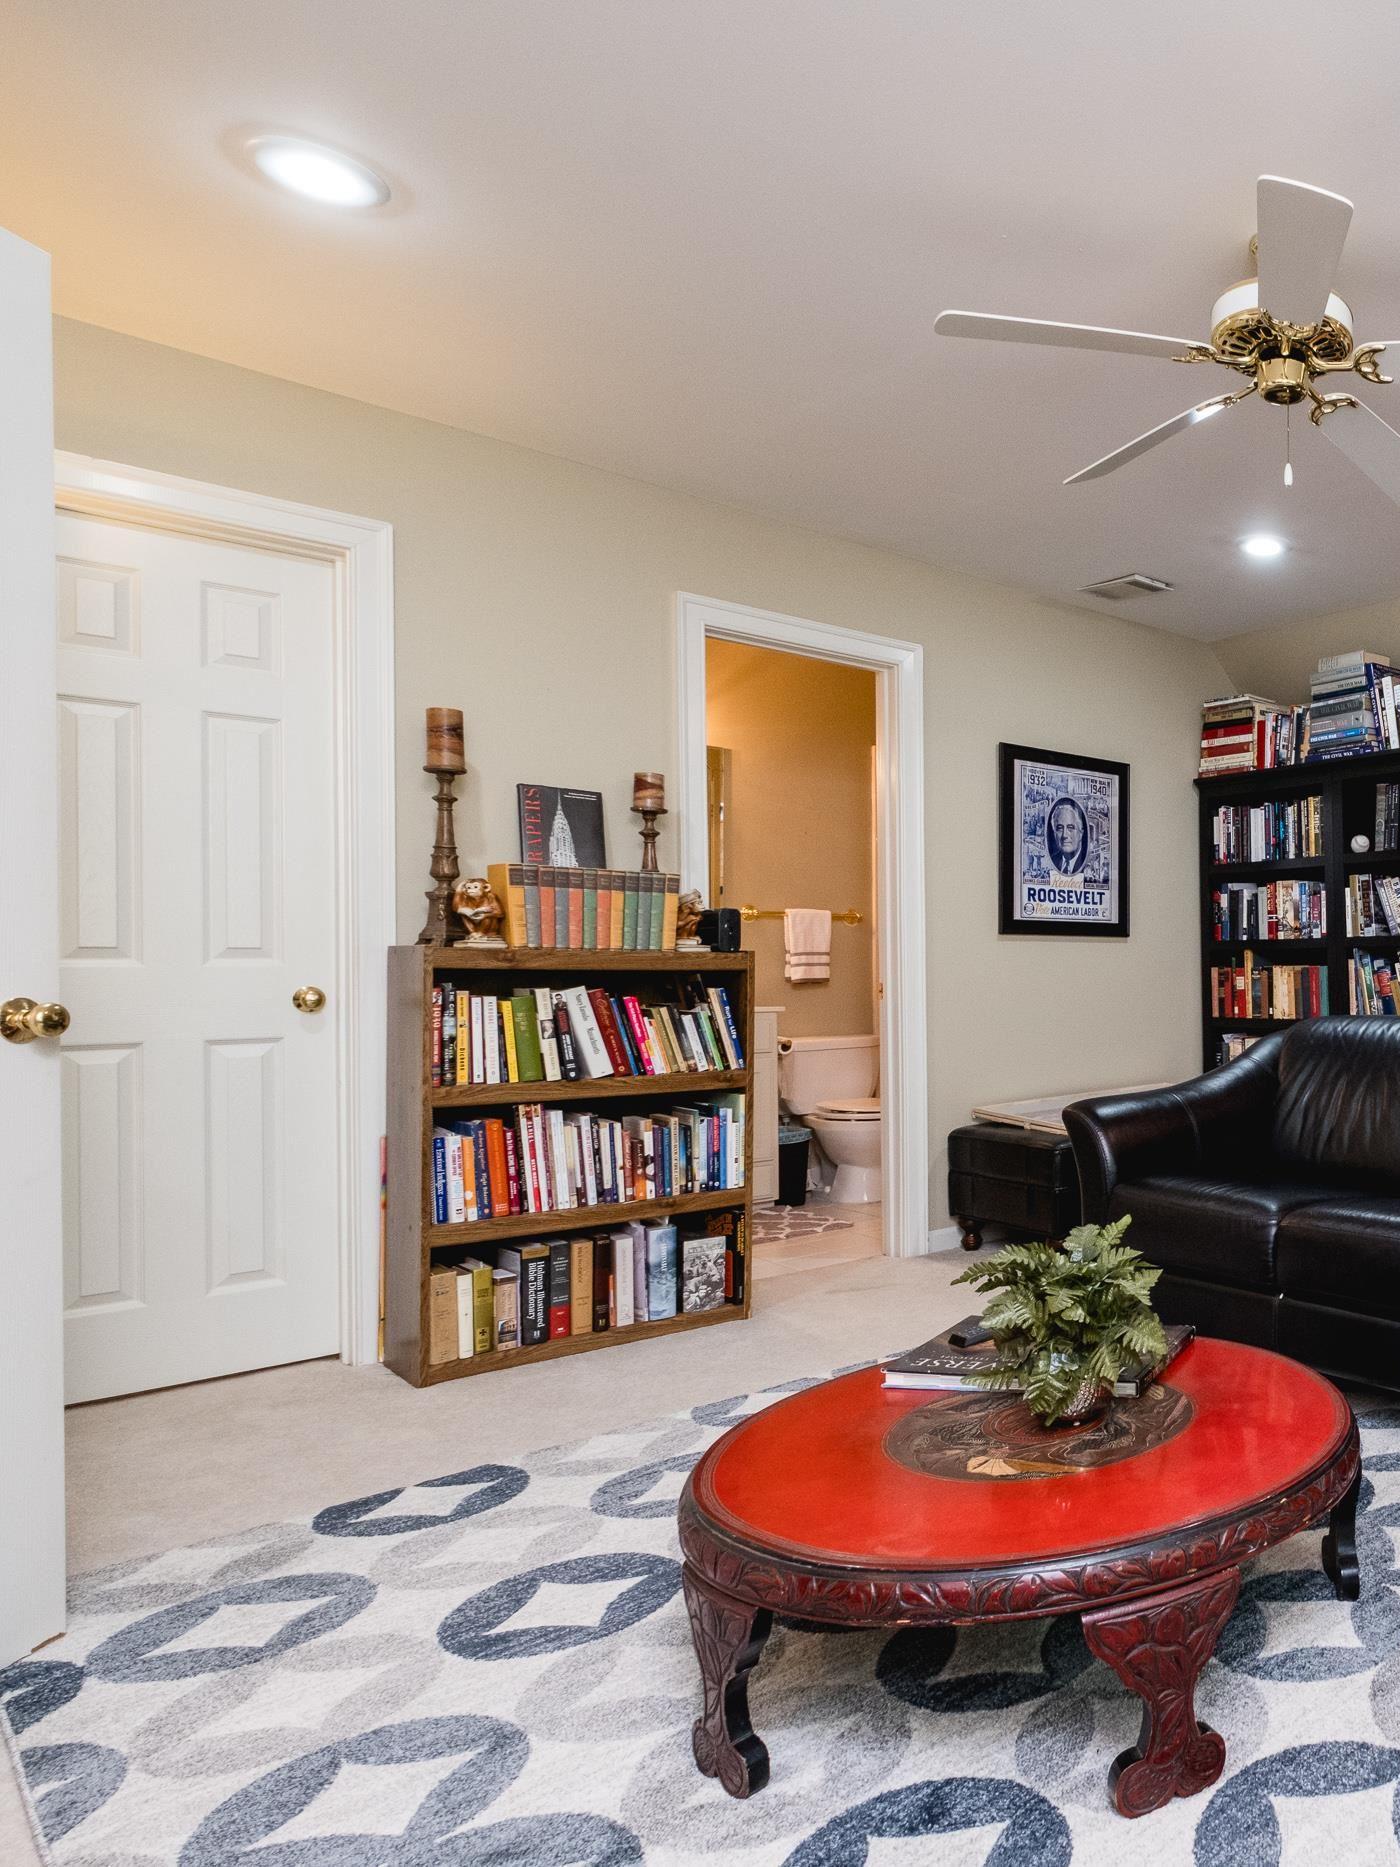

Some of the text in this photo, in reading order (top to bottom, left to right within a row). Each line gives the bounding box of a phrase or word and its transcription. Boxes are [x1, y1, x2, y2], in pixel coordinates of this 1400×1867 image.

[1027, 774, 1046, 786] 1932
[1090, 784, 1107, 796] 1940
[524, 787, 544, 863] RAPERS
[1028, 887, 1105, 905] ROOSEVELT
[1050, 907, 1080, 916] AMERICAN
[1081, 908, 1099, 917] LABOR
[724, 1006, 732, 1018] Run
[527, 1121, 535, 1143] DANIEL
[435, 1148, 445, 1172] Emotional
[478, 1148, 487, 1170] Kingsolver
[526, 1280, 536, 1320] Dictionary
[537, 1290, 545, 1328] Illustrated
[910, 1357, 998, 1371] VERSE
